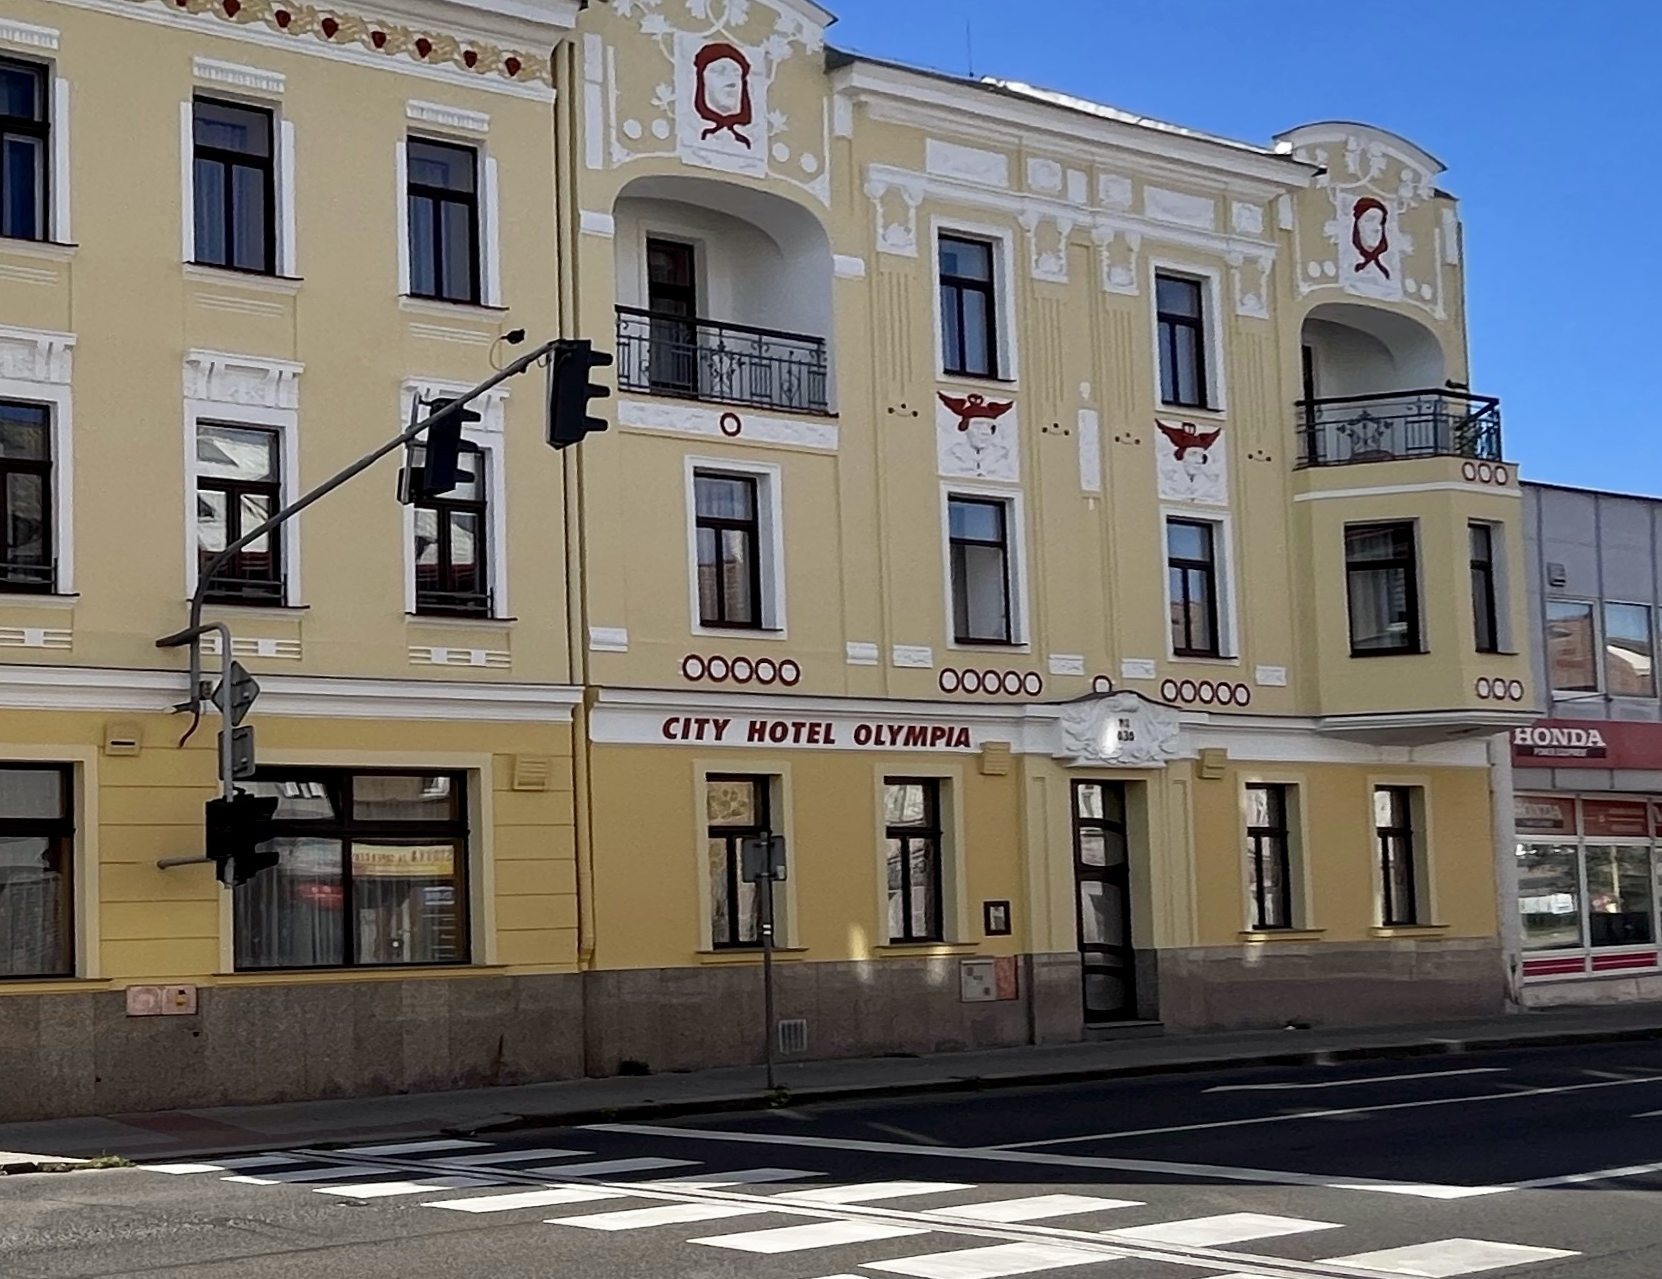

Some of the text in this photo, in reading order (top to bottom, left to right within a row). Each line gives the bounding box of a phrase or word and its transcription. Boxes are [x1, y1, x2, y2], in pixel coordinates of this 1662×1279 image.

[662, 717, 972, 748] CITY HOTEL OLYMPIA
[1513, 727, 1607, 747] HONDA
